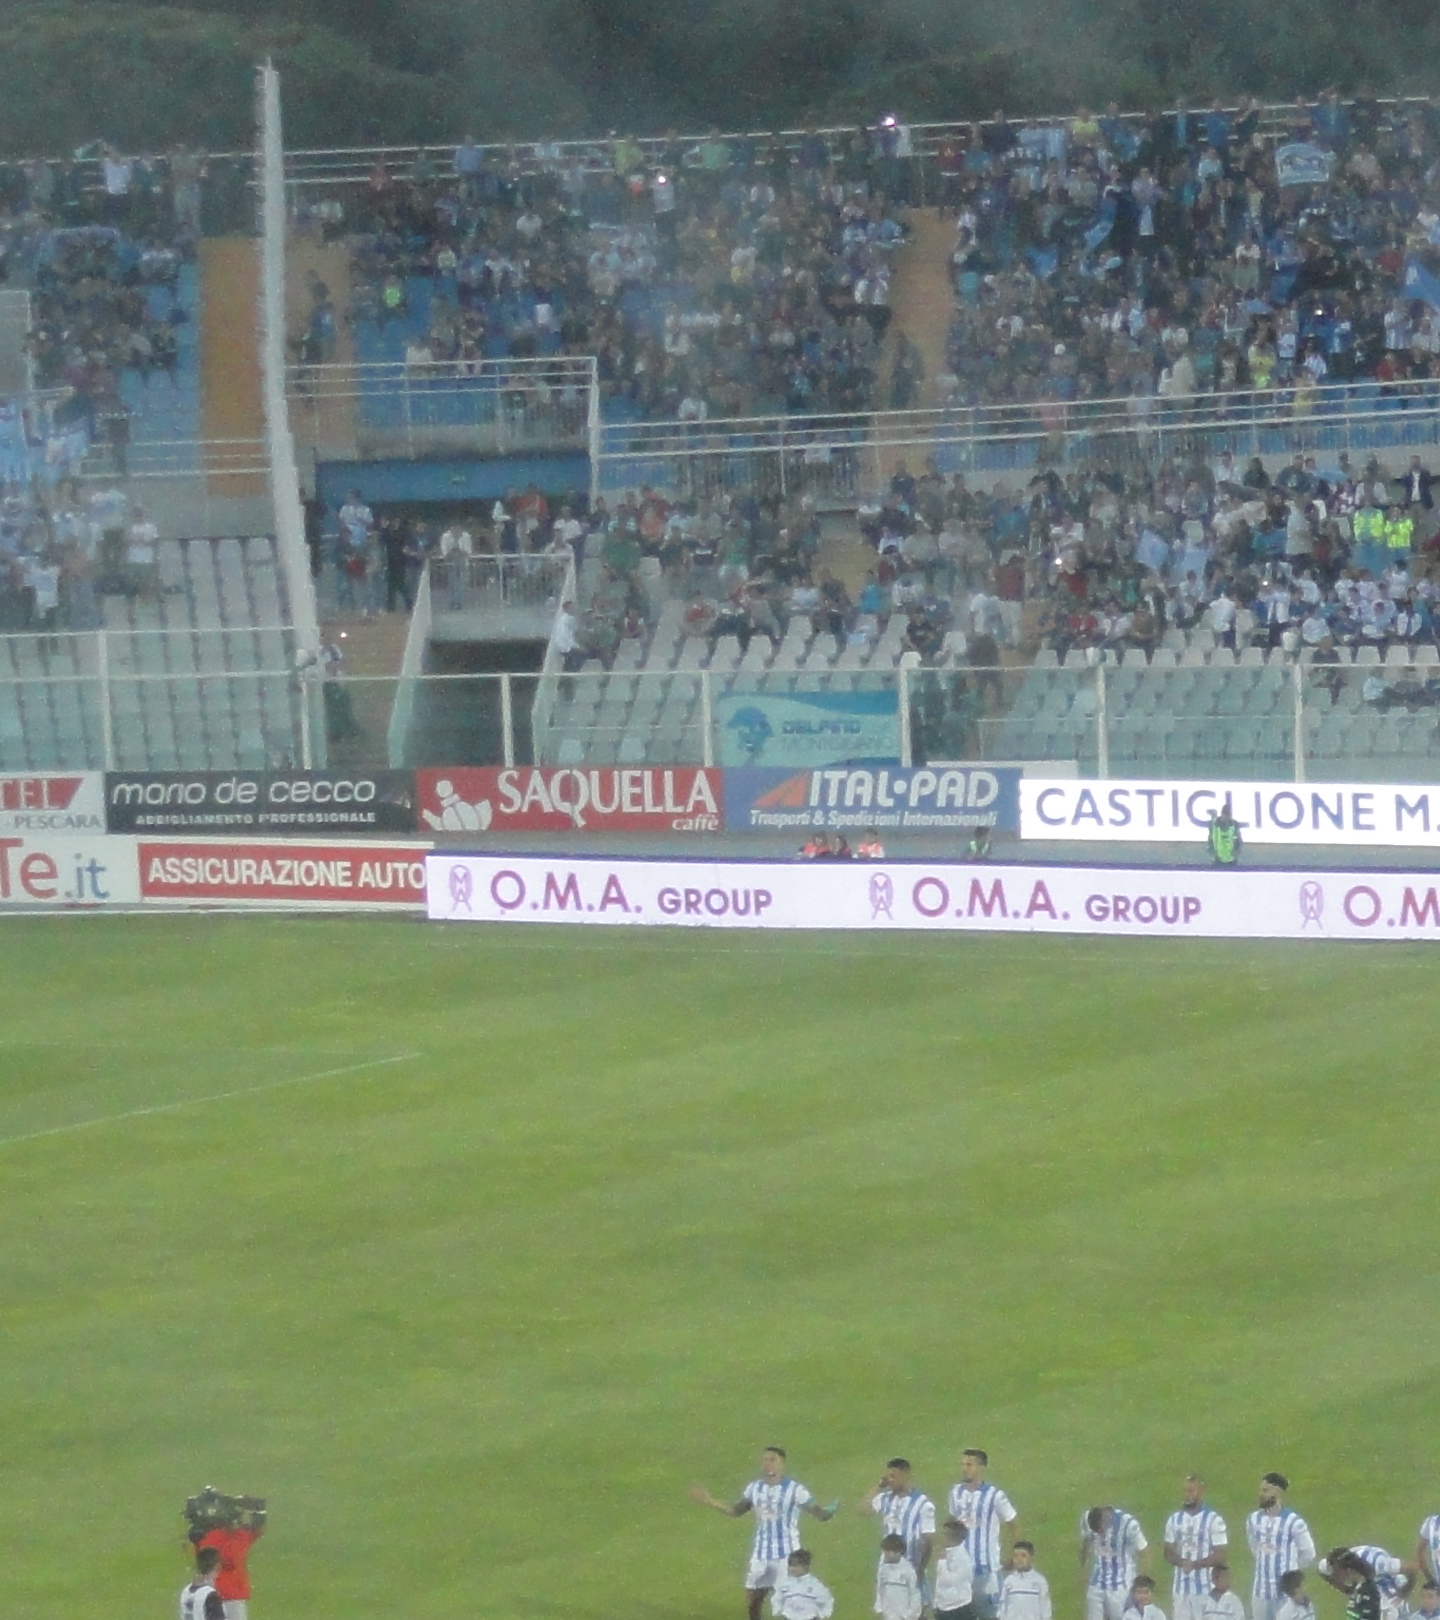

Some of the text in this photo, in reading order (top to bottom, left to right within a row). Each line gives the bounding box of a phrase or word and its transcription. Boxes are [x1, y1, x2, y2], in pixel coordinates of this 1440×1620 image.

[112, 776, 376, 805] mario de cecco
[497, 768, 718, 828] SAQUELLA
[14, 814, 101, 830] PESCARA
[671, 811, 720, 832] caffè
[812, 810, 826, 826] &
[828, 810, 901, 829] Spedizioni
[902, 810, 998, 828] Internazionali
[1035, 788, 1389, 831] CASTIGLIONE
[148, 856, 426, 889] ASSICURAZIONE AUTO
[489, 868, 774, 917] O.M.A. GROUP
[911, 876, 1202, 925] O.M.A. GROUP
